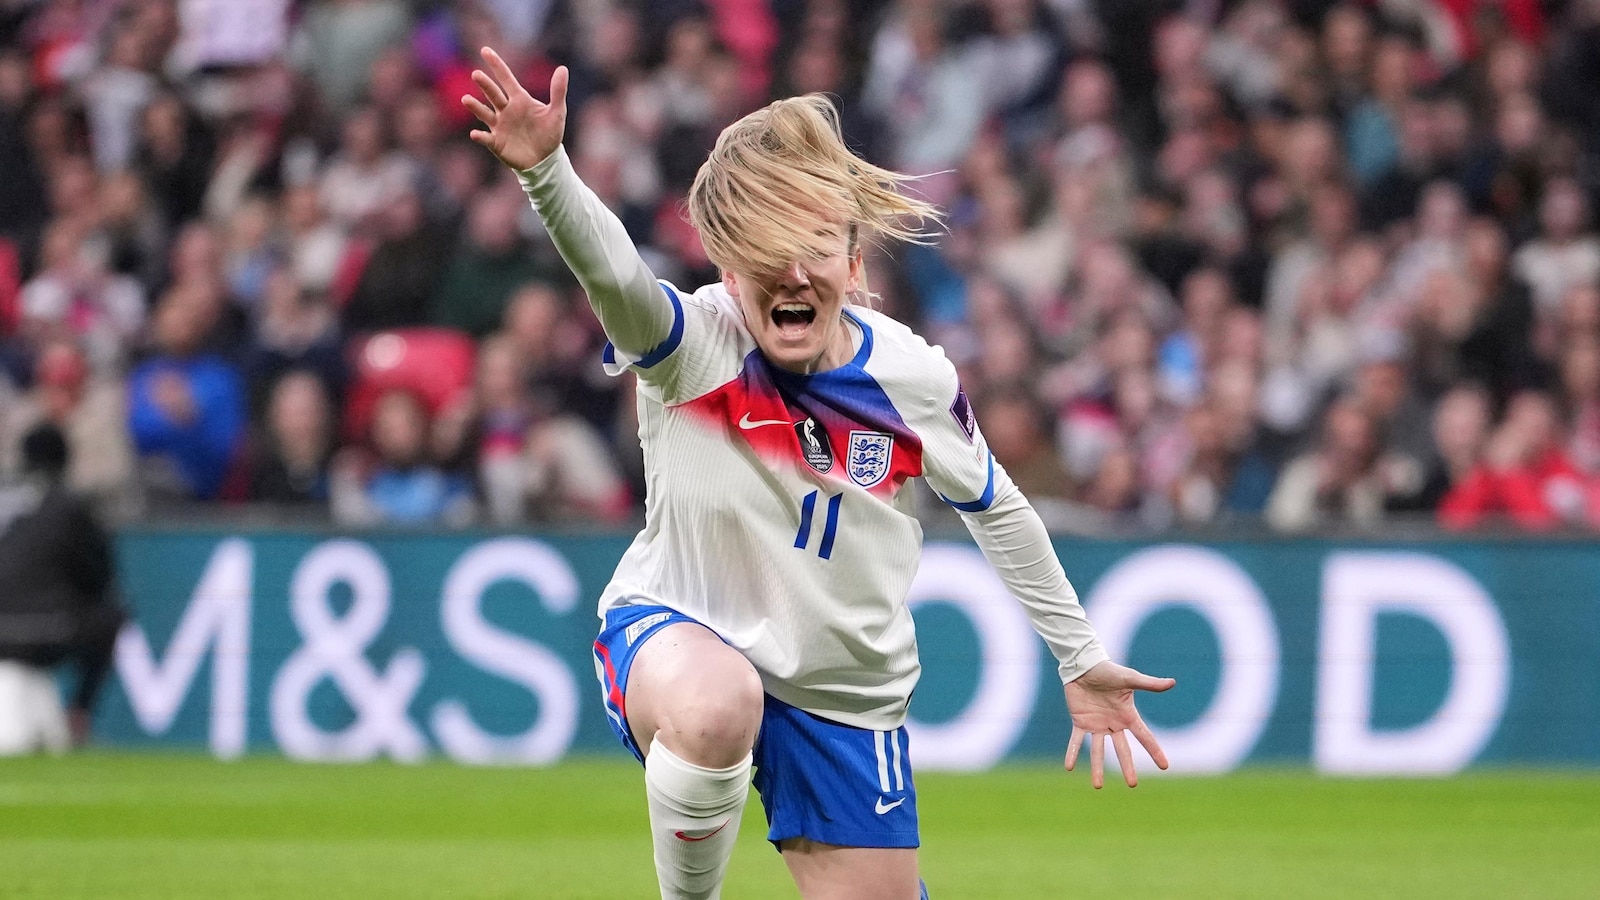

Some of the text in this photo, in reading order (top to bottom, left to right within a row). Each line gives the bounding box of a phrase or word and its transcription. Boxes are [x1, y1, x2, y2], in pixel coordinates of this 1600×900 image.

[793, 489, 844, 561] 11
[113, 536, 1513, 776] M&S OOD
